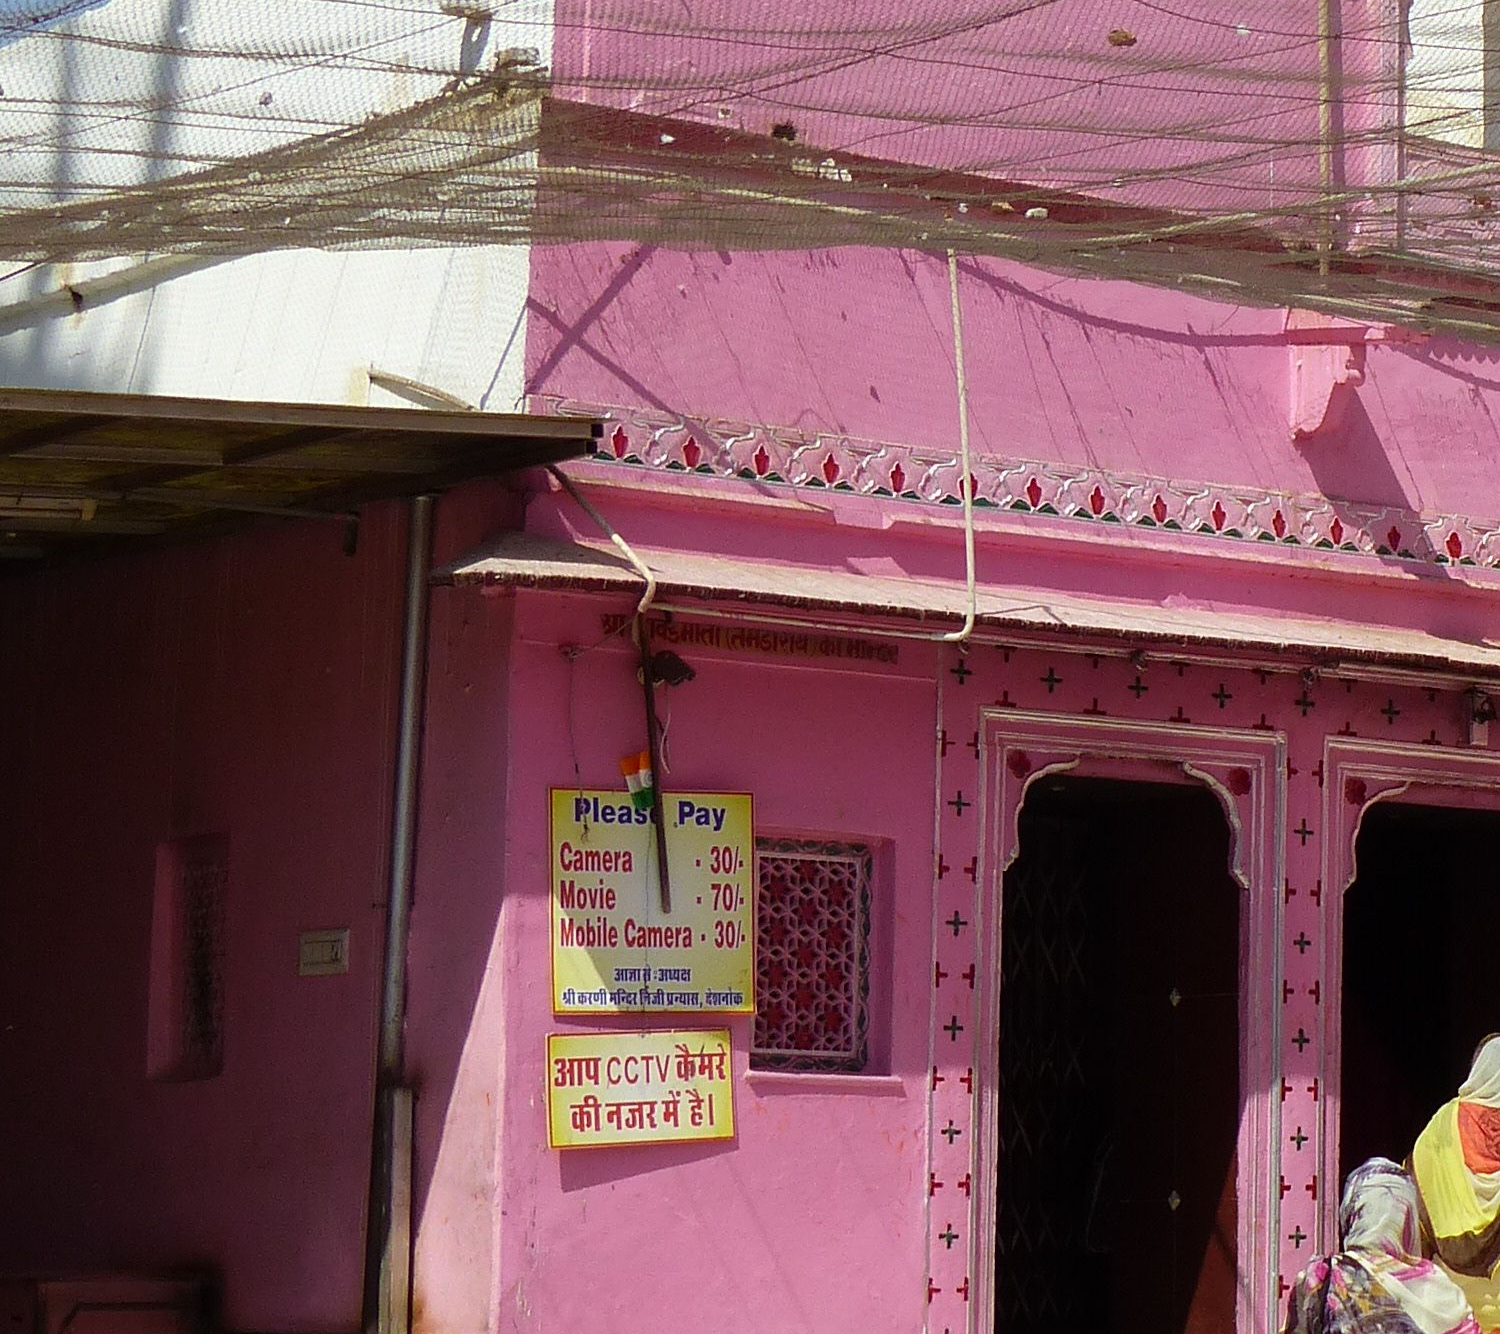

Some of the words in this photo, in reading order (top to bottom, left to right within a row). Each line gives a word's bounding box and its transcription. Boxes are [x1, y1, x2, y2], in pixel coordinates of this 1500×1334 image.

[678, 800, 726, 831] Pay
[559, 842, 633, 873] Camera
[710, 845, 744, 875] 30/-
[560, 879, 616, 910] Movie
[711, 883, 745, 912] 70/-
[560, 917, 618, 948] Mobile
[624, 918, 692, 948] Camera
[714, 920, 746, 949] 30/-
[562, 988, 575, 1005] श्री
[554, 1058, 600, 1087] आप
[607, 1054, 670, 1085] CCTV
[570, 1095, 601, 1132] की
[605, 1100, 657, 1131] नजर
[661, 1089, 681, 1128] में
